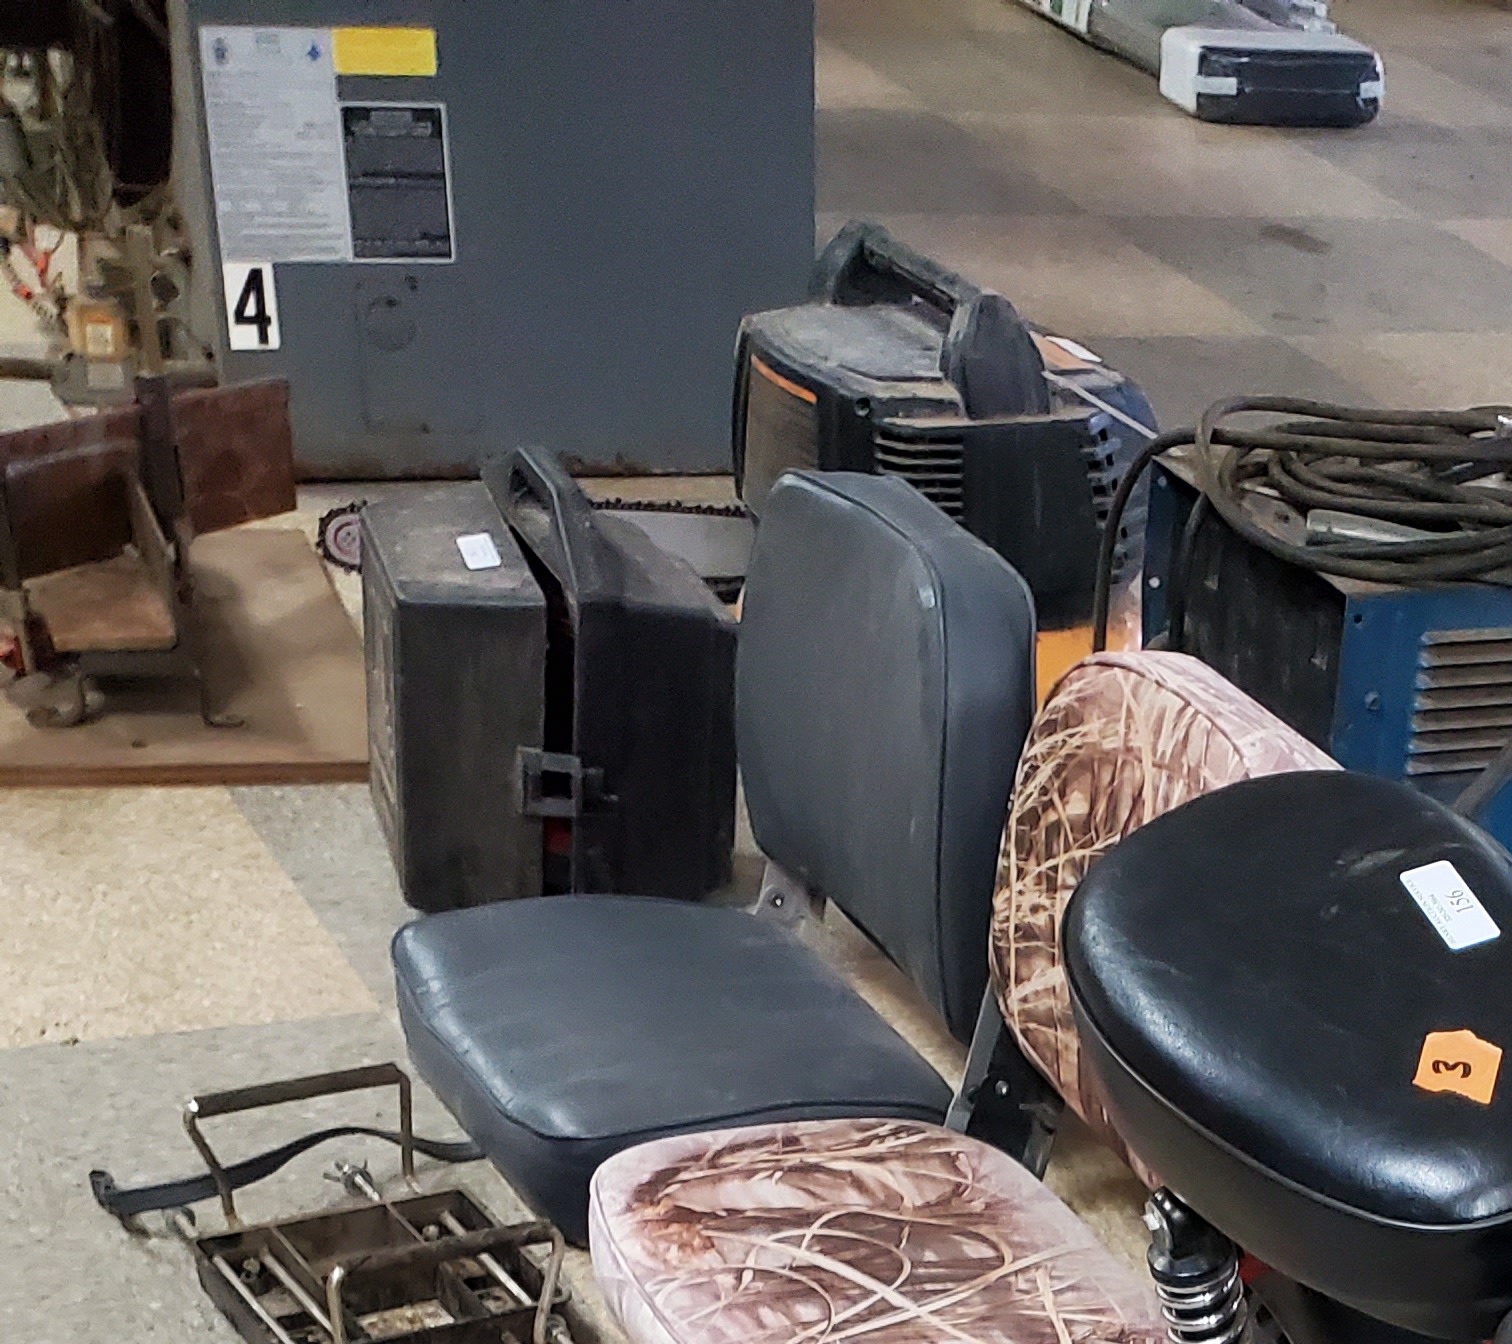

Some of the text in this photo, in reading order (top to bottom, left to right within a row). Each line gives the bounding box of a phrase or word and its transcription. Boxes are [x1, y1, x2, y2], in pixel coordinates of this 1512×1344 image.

[234, 267, 272, 346] 4
[1444, 889, 1474, 913] 156
[1431, 1059, 1472, 1079] 3
